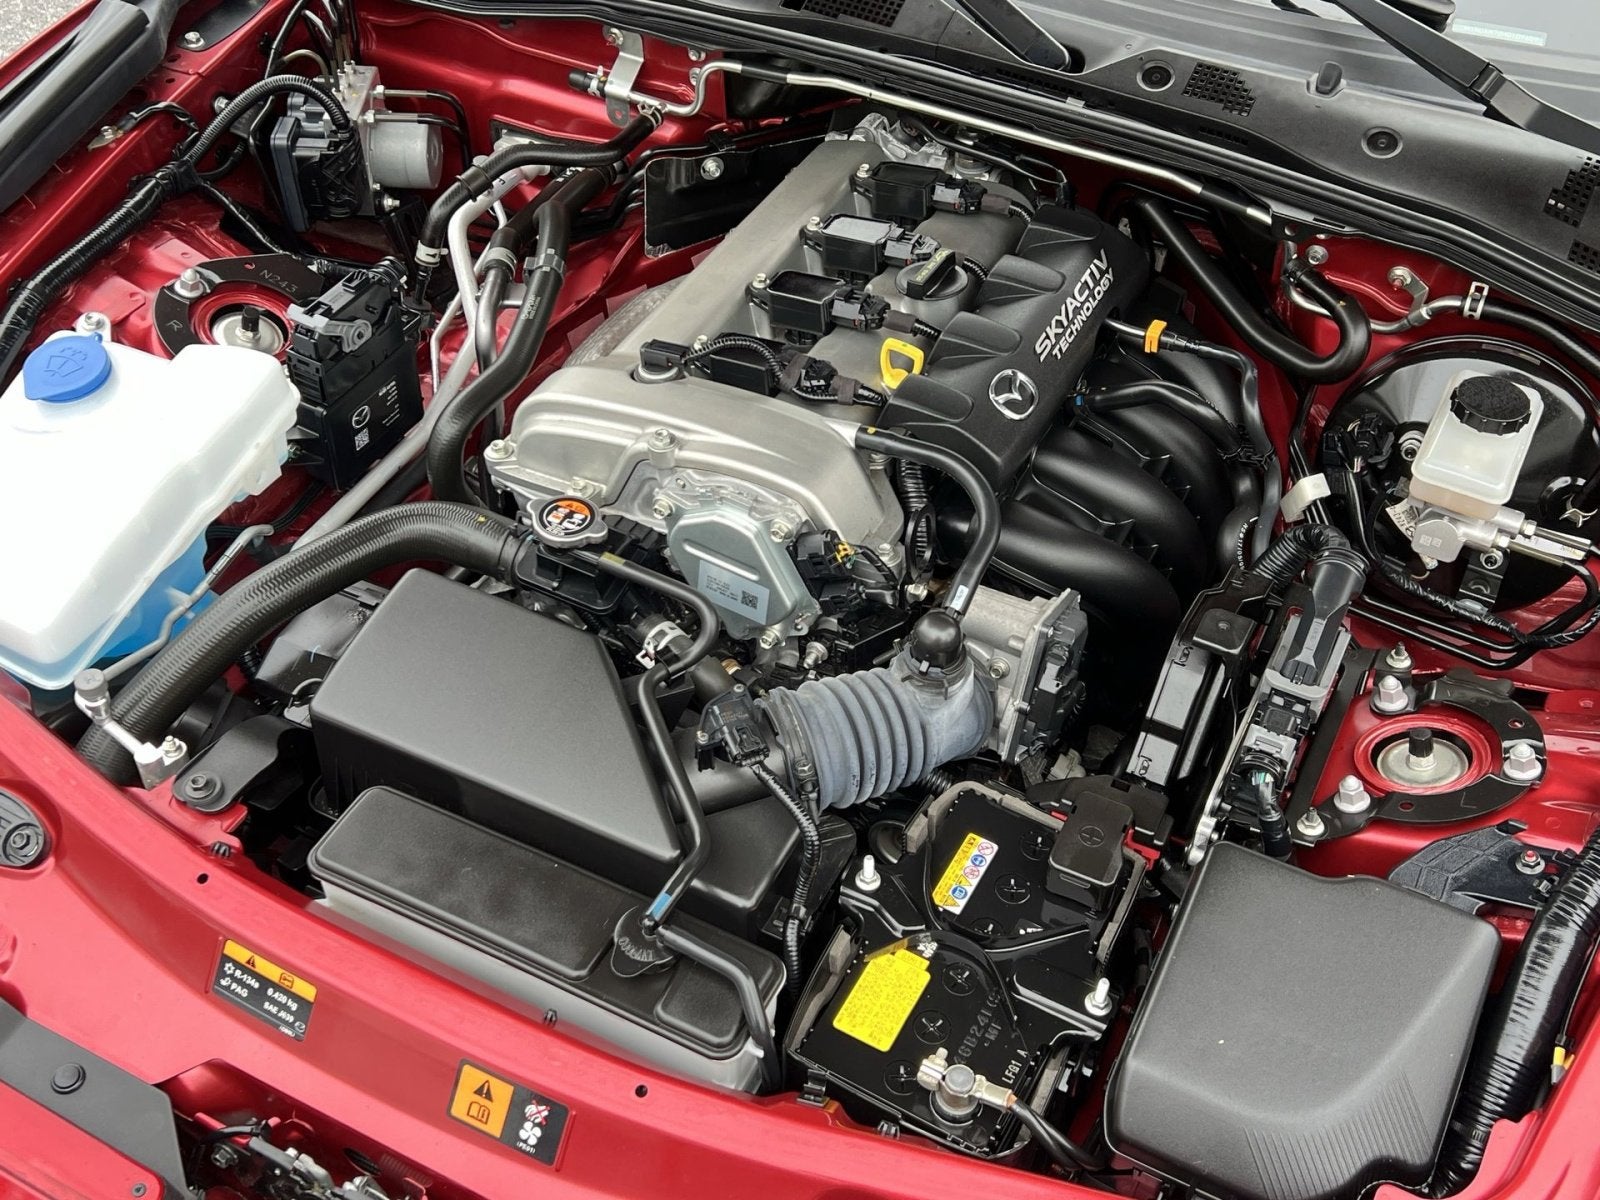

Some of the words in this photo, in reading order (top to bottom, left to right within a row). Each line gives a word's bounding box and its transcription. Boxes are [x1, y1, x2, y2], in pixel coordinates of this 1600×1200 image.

[259, 269, 298, 293] N243
[1035, 248, 1108, 362] SKYACTIV
[1052, 267, 1113, 359] TECHNOLOGY
[167, 319, 183, 332] R
[1460, 791, 1478, 809] L
[229, 982, 249, 998] PAG
[263, 1002, 278, 1014] SAE
[286, 998, 298, 1012] kg
